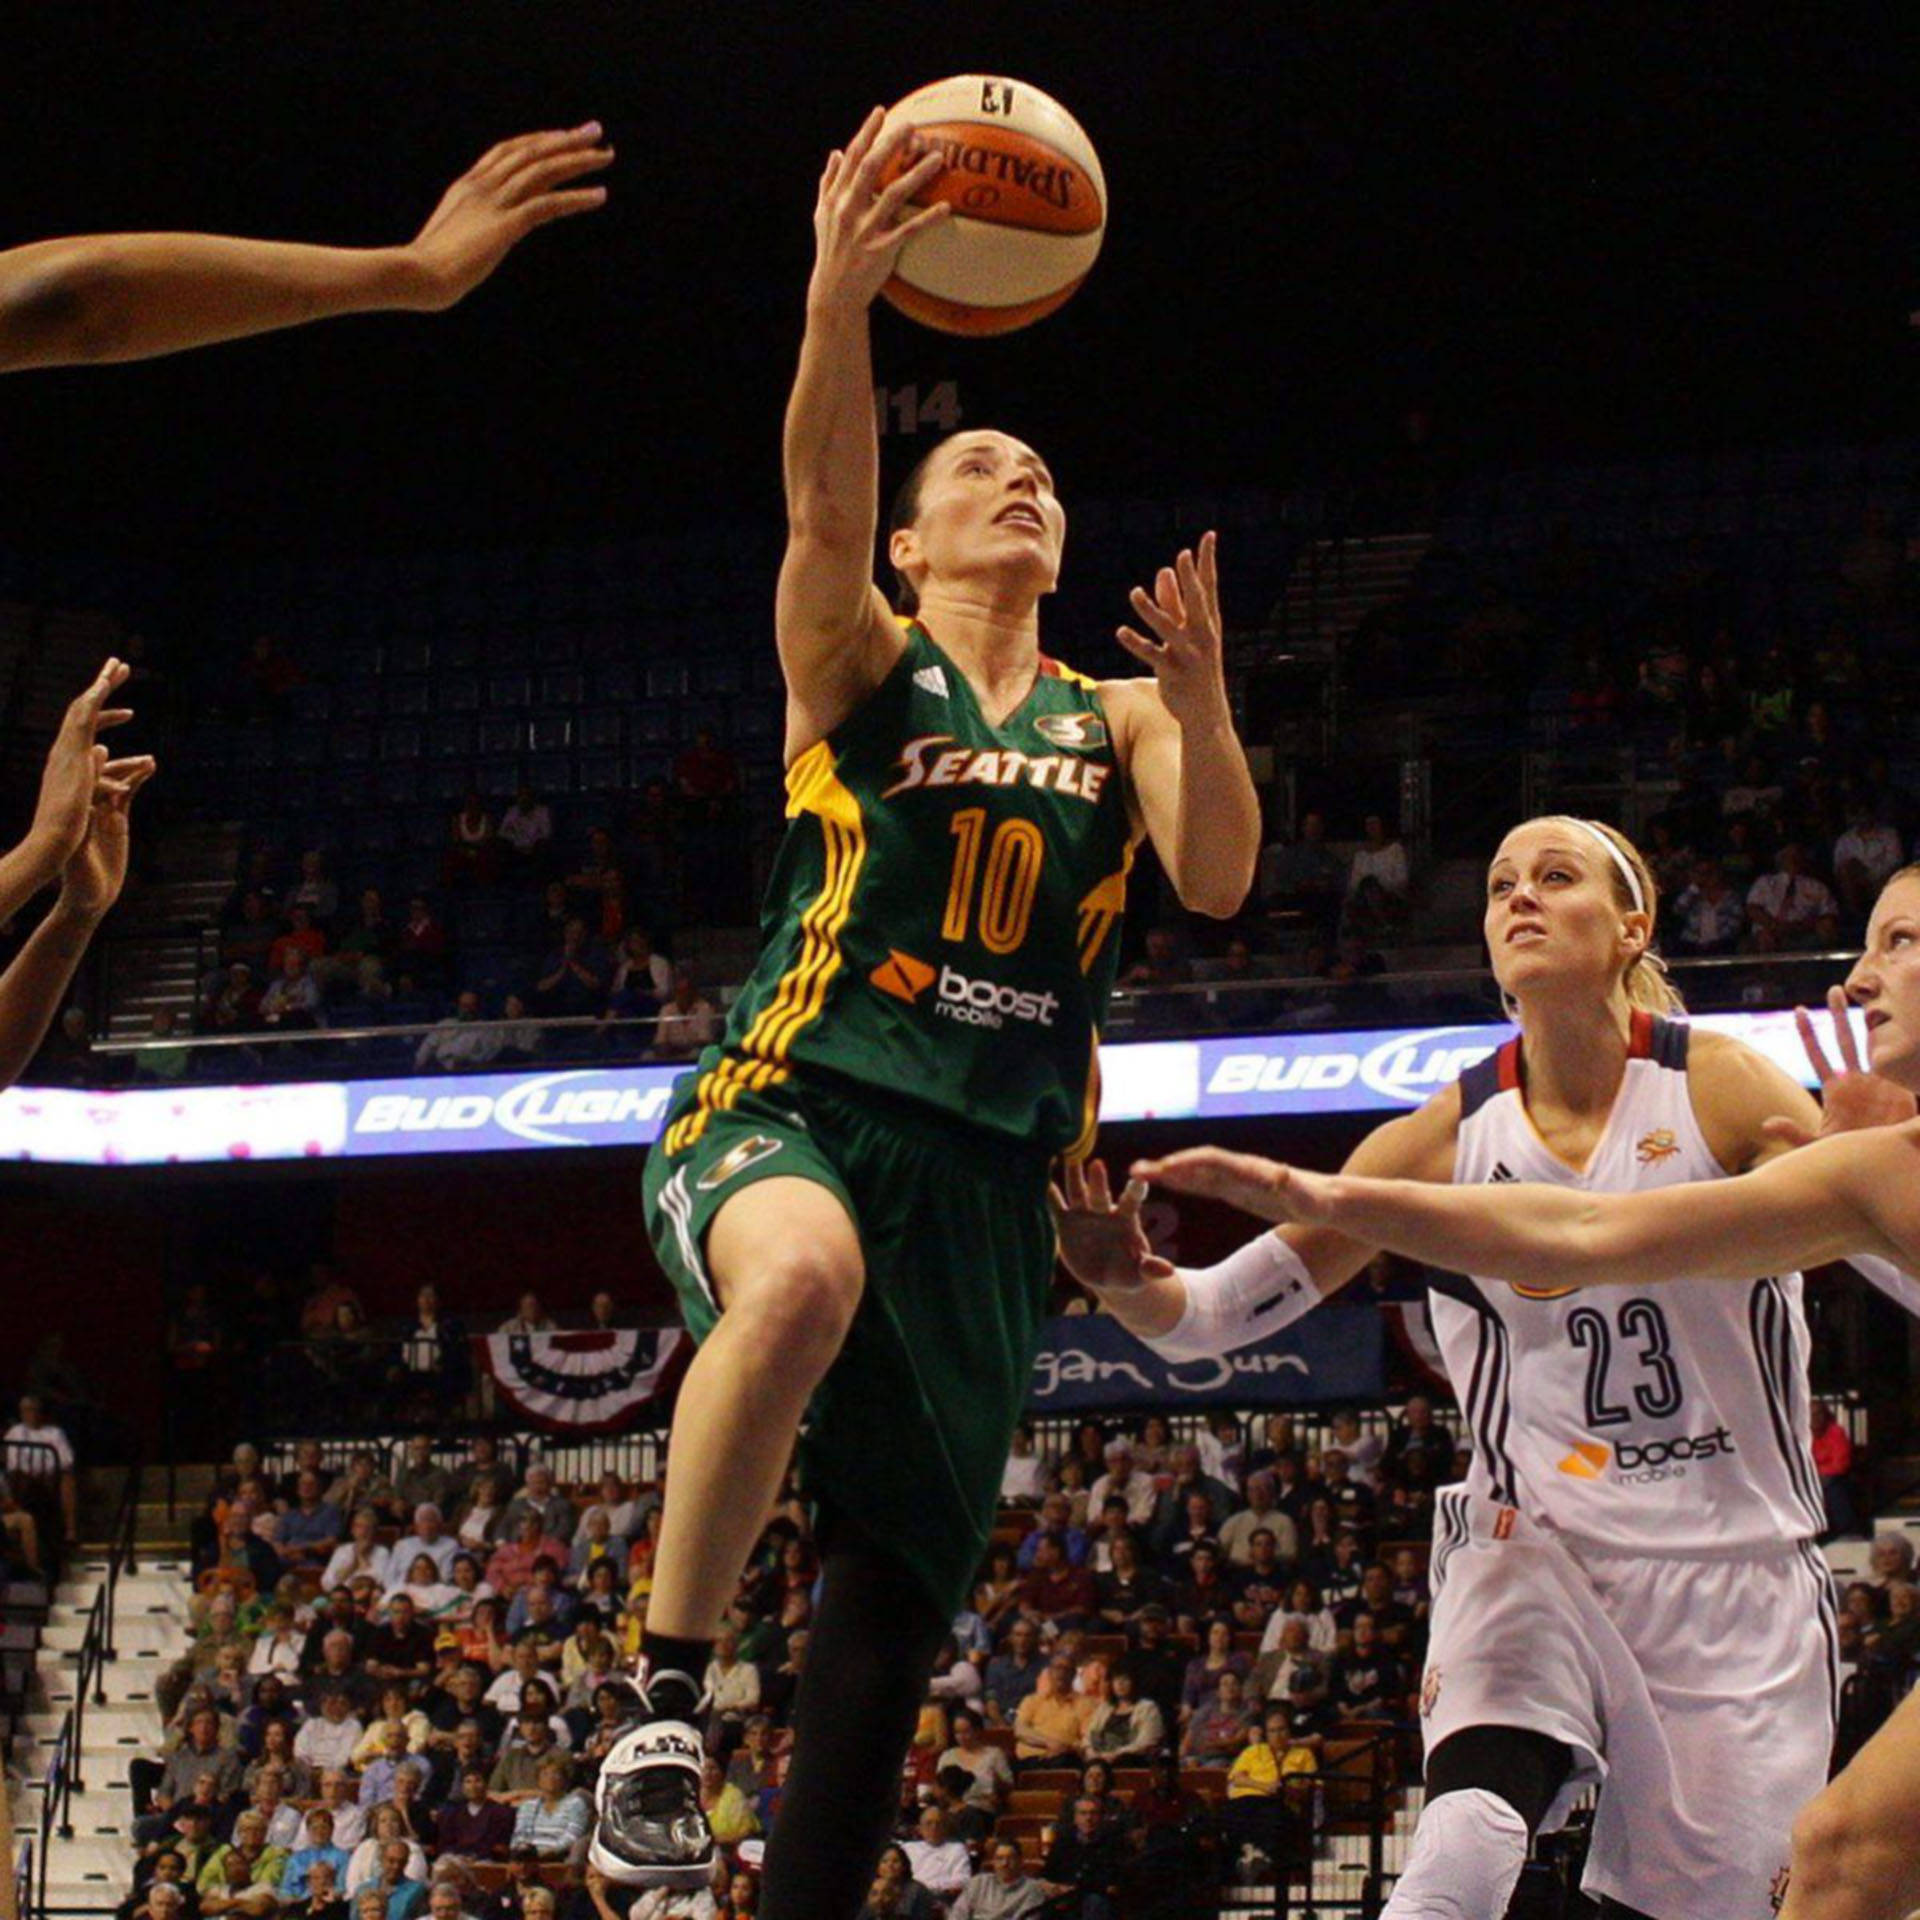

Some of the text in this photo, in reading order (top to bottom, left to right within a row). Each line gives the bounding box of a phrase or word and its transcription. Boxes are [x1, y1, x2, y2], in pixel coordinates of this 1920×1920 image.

[882, 735, 1111, 803] SEATTLE
[942, 807, 1045, 955] 10
[939, 963, 1059, 1026] boost
[1206, 1053, 1360, 1095] BUD
[354, 1096, 496, 1133] BUD
[1566, 1298, 1683, 1428] 23
[1613, 1426, 1735, 1469] boost
